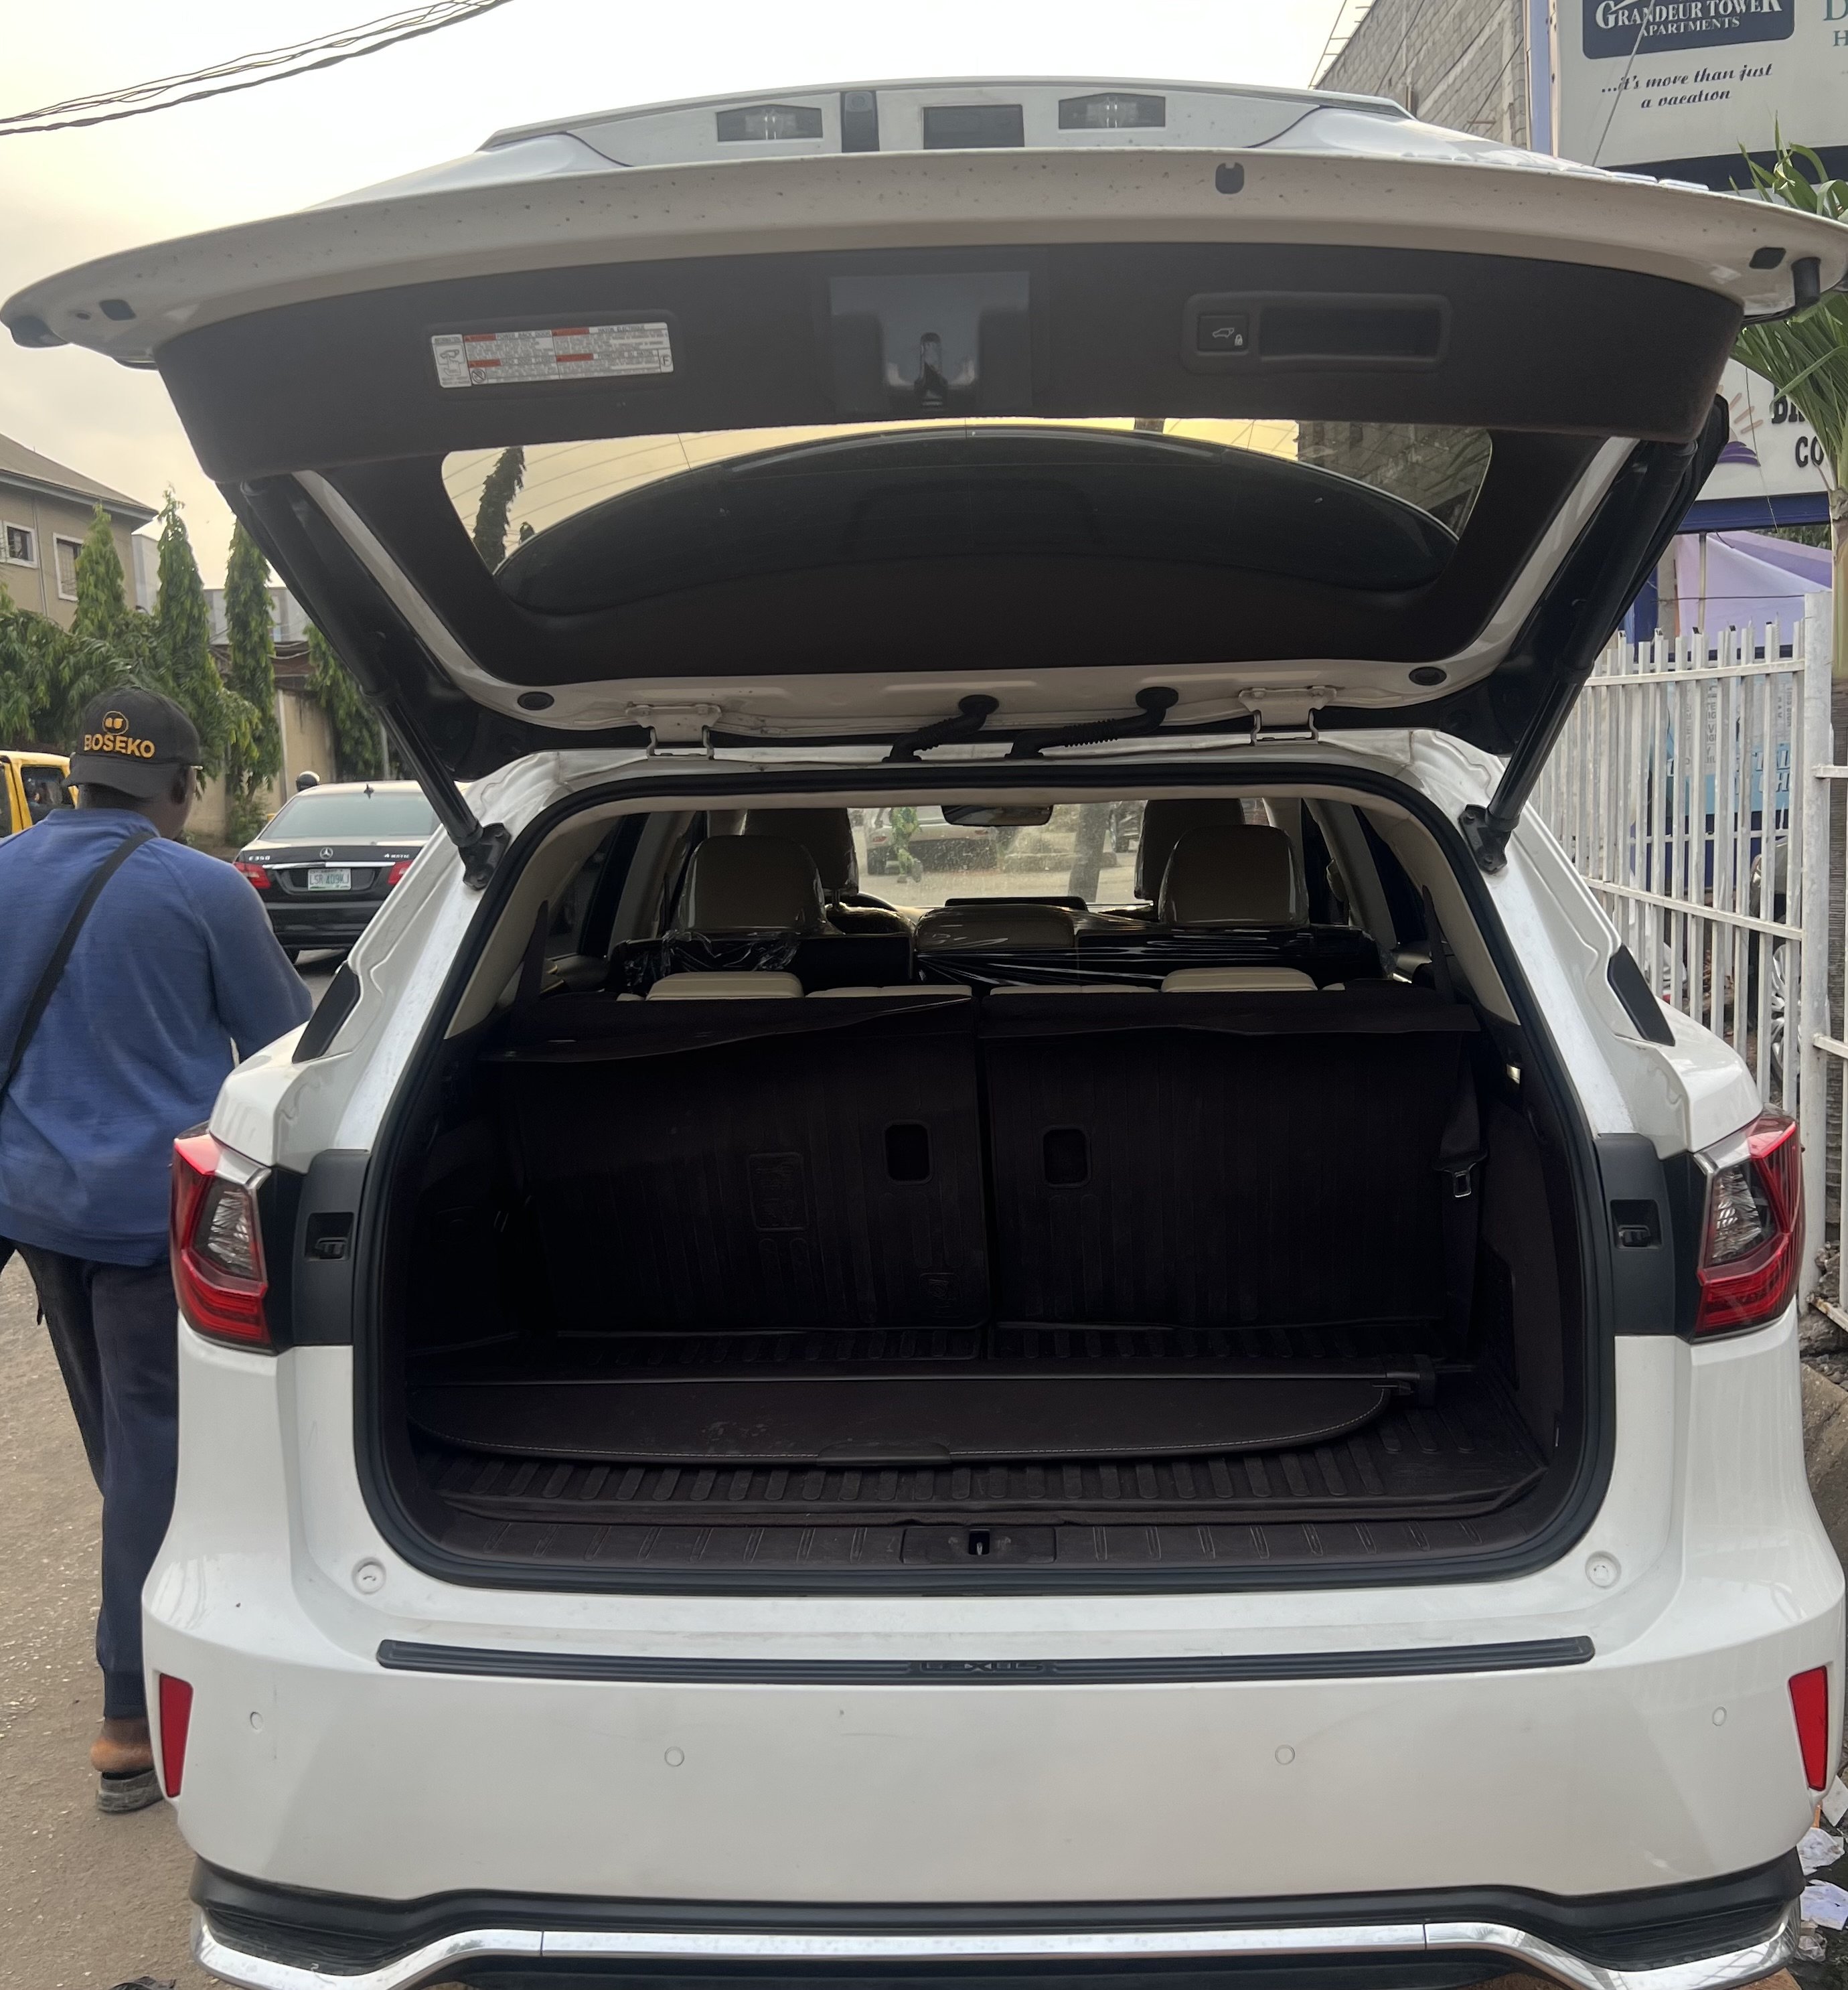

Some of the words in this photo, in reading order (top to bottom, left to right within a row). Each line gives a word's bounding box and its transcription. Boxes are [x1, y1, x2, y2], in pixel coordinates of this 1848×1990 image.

[1596, 0, 1703, 29] GRANDEUR
[1642, 16, 1740, 36] APARTMENTS
[1646, 74, 1689, 88] more
[1694, 67, 1736, 83] than
[1740, 63, 1773, 81] just
[1640, 98, 1652, 108] a
[1658, 89, 1731, 106] vacation
[84, 733, 155, 758] BOSEKO
